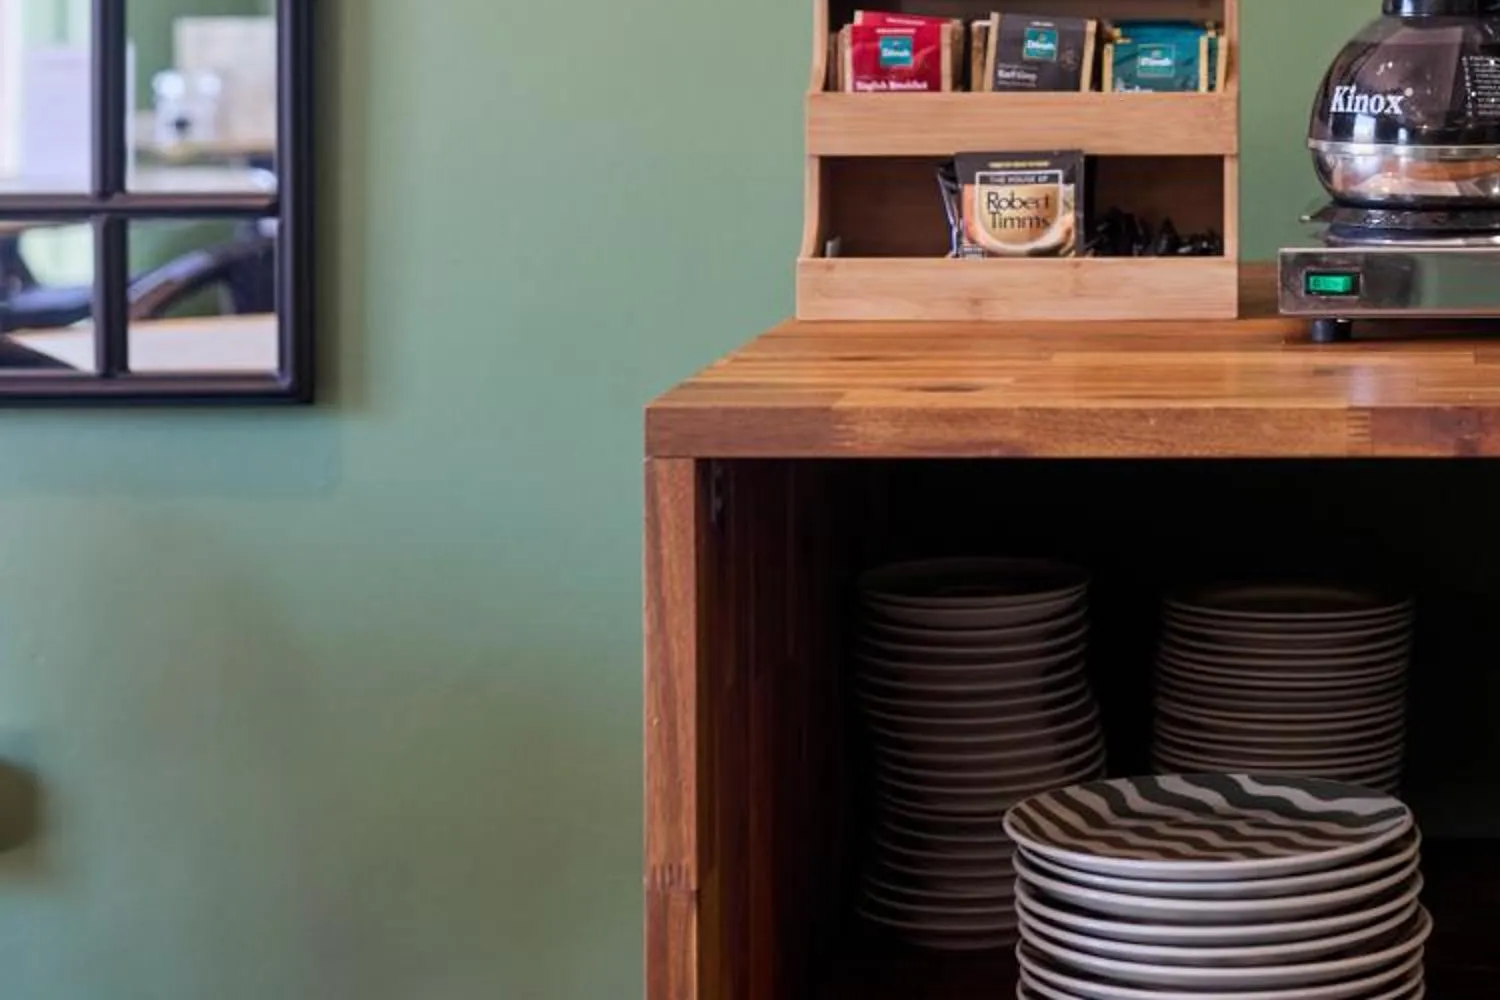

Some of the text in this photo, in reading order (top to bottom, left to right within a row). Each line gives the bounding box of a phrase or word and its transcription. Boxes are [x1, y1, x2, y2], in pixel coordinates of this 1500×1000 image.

[1329, 83, 1404, 115] Kinox
[987, 190, 1050, 211] Robert
[990, 211, 1052, 229] Timms
